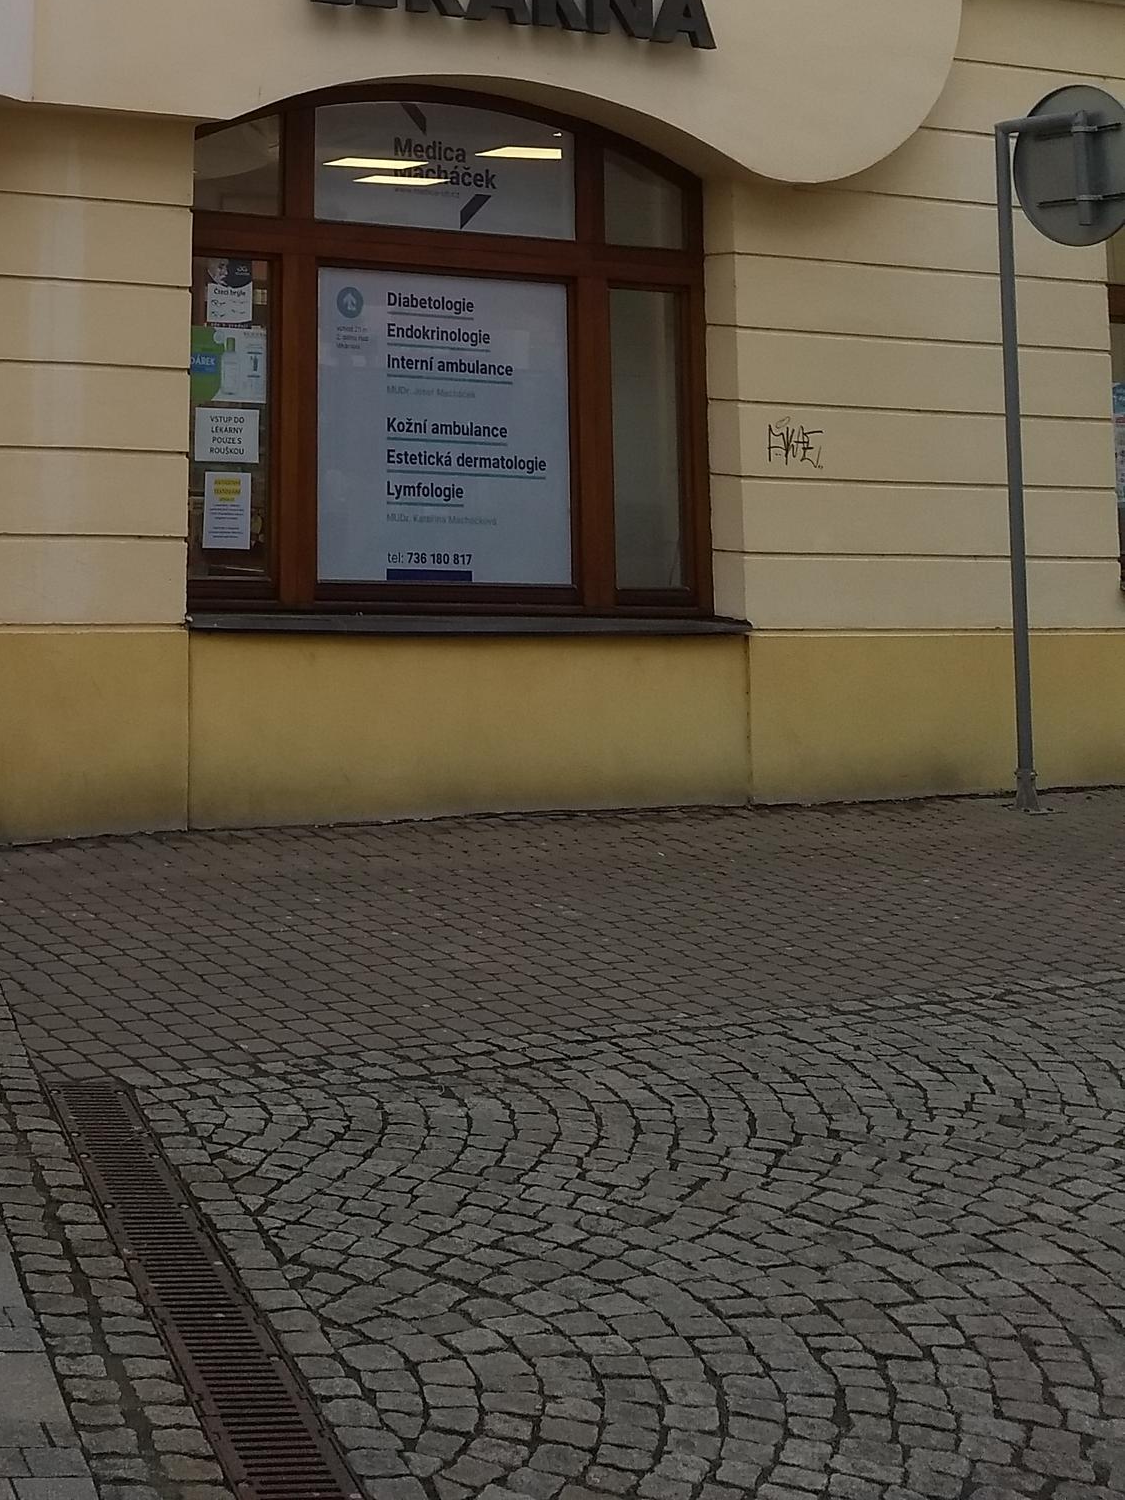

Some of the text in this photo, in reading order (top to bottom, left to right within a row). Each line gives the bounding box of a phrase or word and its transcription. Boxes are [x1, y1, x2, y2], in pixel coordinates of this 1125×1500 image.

[393, 136, 467, 164] Medica
[386, 291, 475, 315] Diabetologie
[386, 322, 491, 347] Endokrinologie
[386, 353, 514, 376] Interní ambulance
[209, 415, 245, 424] VSTUP DO
[386, 417, 508, 439] Kožní ambulance
[209, 447, 245, 455] ROUŠKOU
[211, 436, 243, 445] POUZE S
[386, 449, 547, 475] Estetická dermatologie
[386, 480, 464, 502] Lymfologie
[387, 552, 473, 566] tel: 736 180 817
